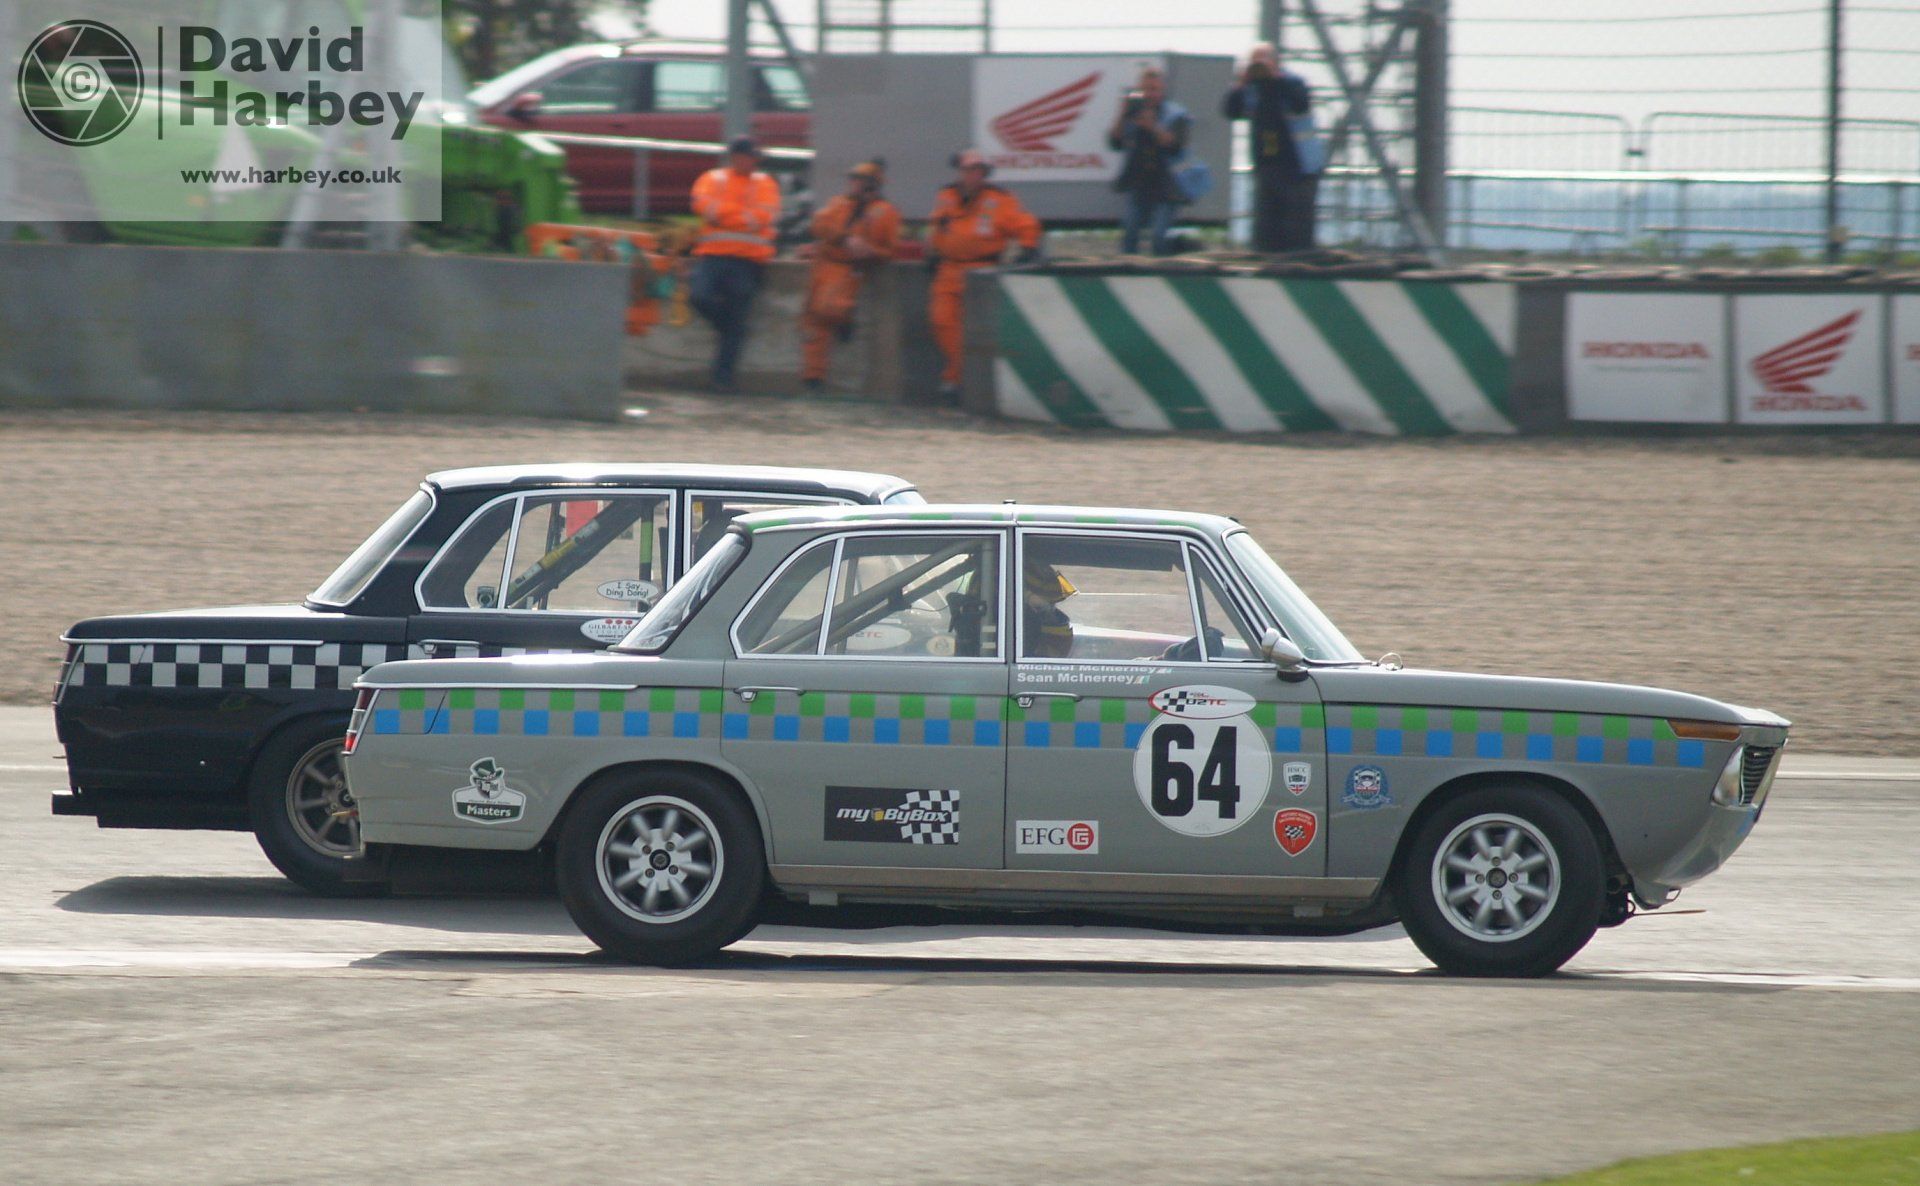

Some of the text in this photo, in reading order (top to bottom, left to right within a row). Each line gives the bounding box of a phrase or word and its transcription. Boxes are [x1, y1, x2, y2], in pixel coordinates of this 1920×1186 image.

[1582, 342, 1709, 359] HONDA
[1751, 395, 1867, 411] HONDA
[606, 588, 649, 598] Ding Dong!
[1017, 663, 1157, 675] Michael McInerney
[1017, 673, 1135, 686] Sean McInerney
[1151, 723, 1241, 819] 64
[467, 804, 511, 816] Masters
[1020, 827, 1065, 846] EFG
